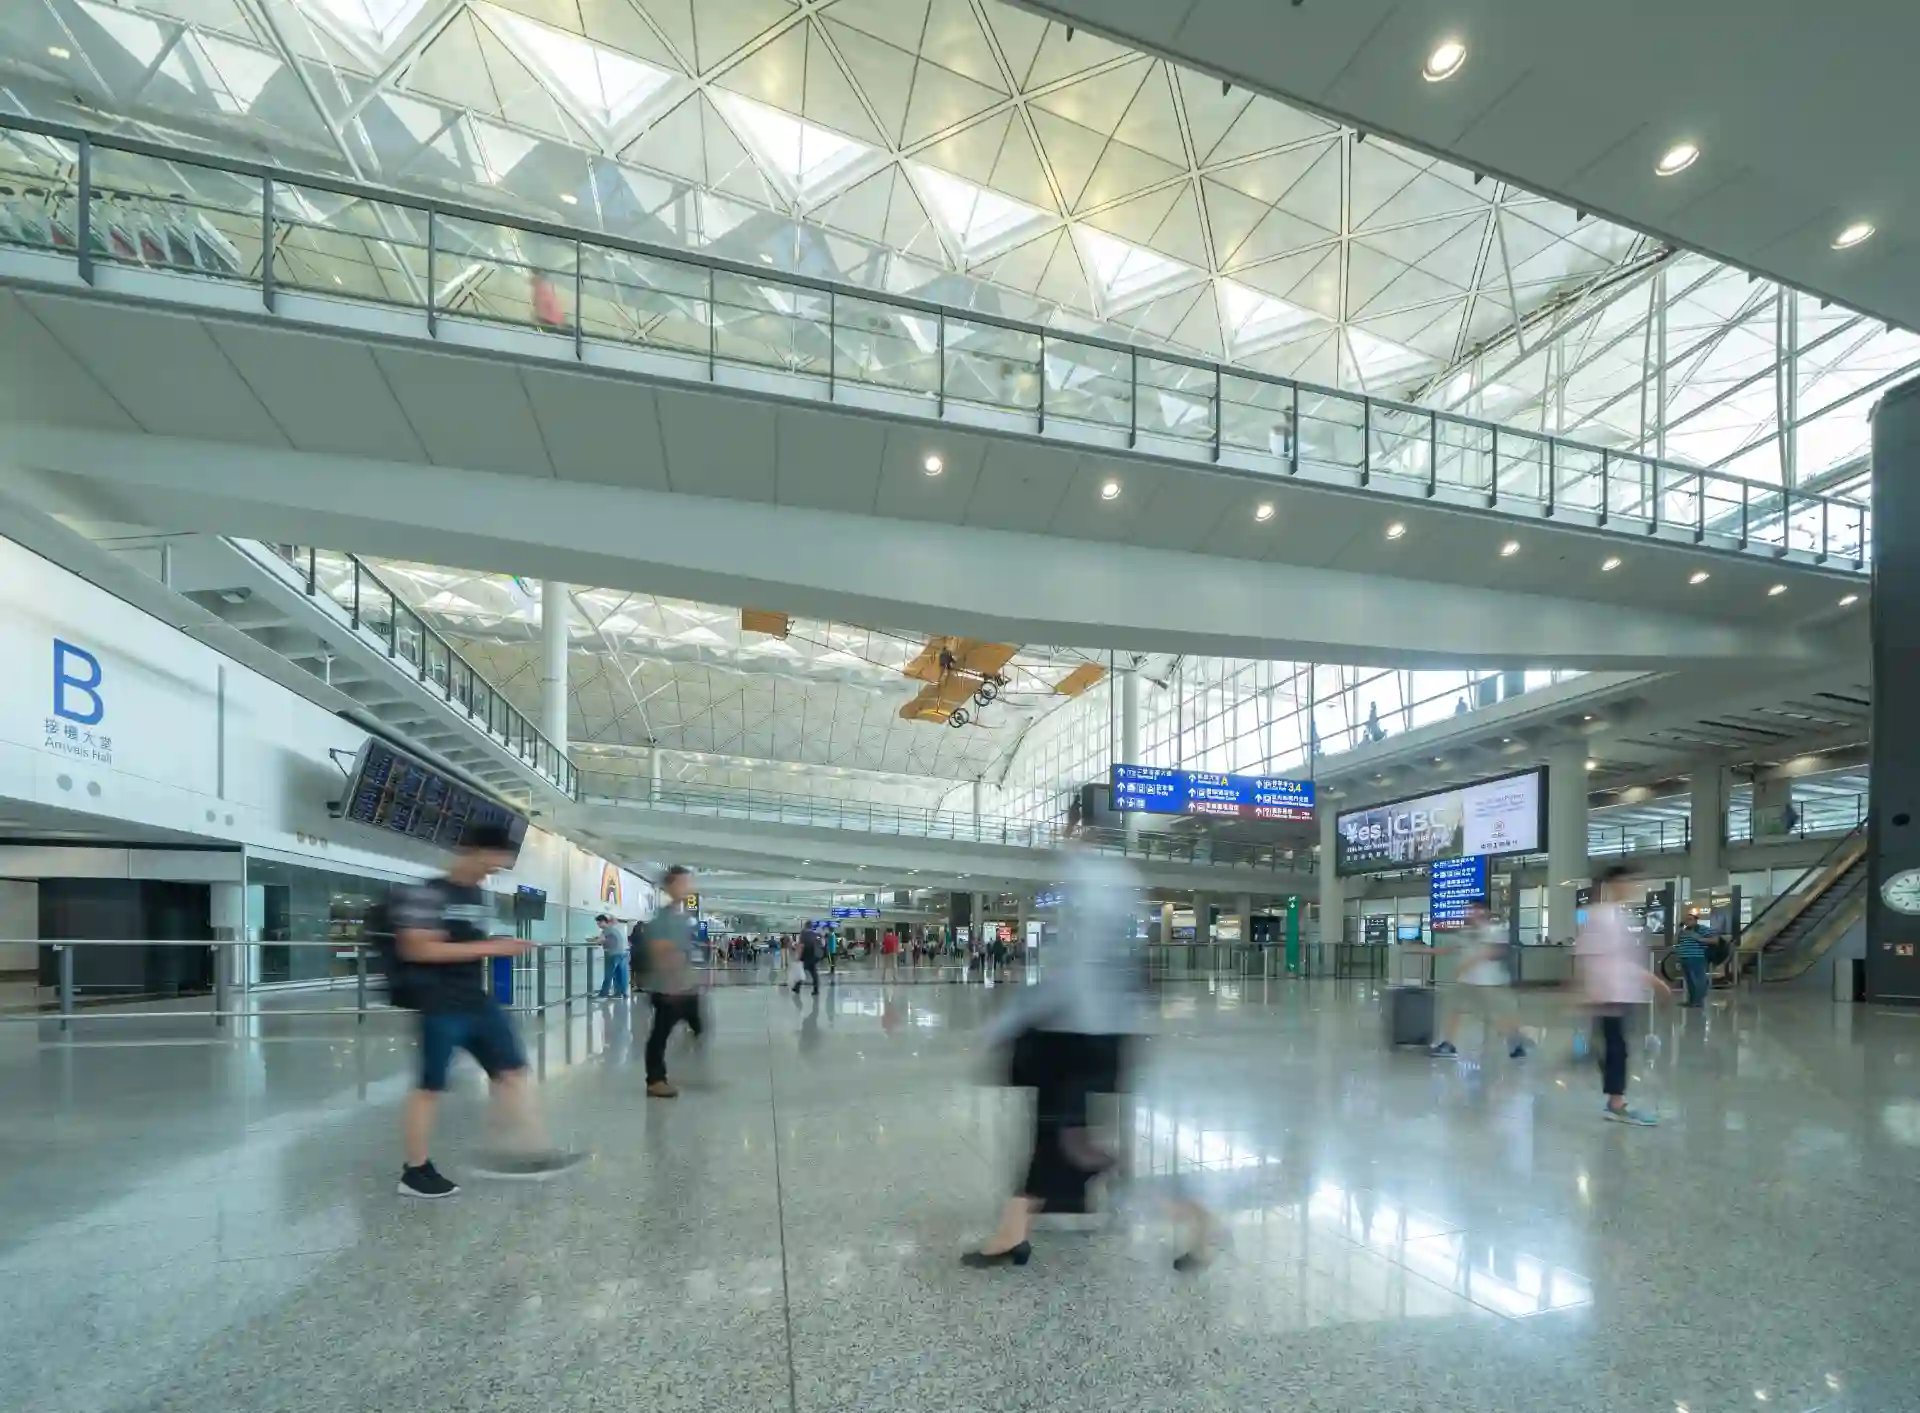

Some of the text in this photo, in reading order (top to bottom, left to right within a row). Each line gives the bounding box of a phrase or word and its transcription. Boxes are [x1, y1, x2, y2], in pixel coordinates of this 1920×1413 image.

[54, 638, 104, 725] B
[92, 748, 112, 765] Hall
[1221, 775, 1228, 785] A
[1388, 809, 1446, 837] ICBC
[687, 894, 697, 907] B
